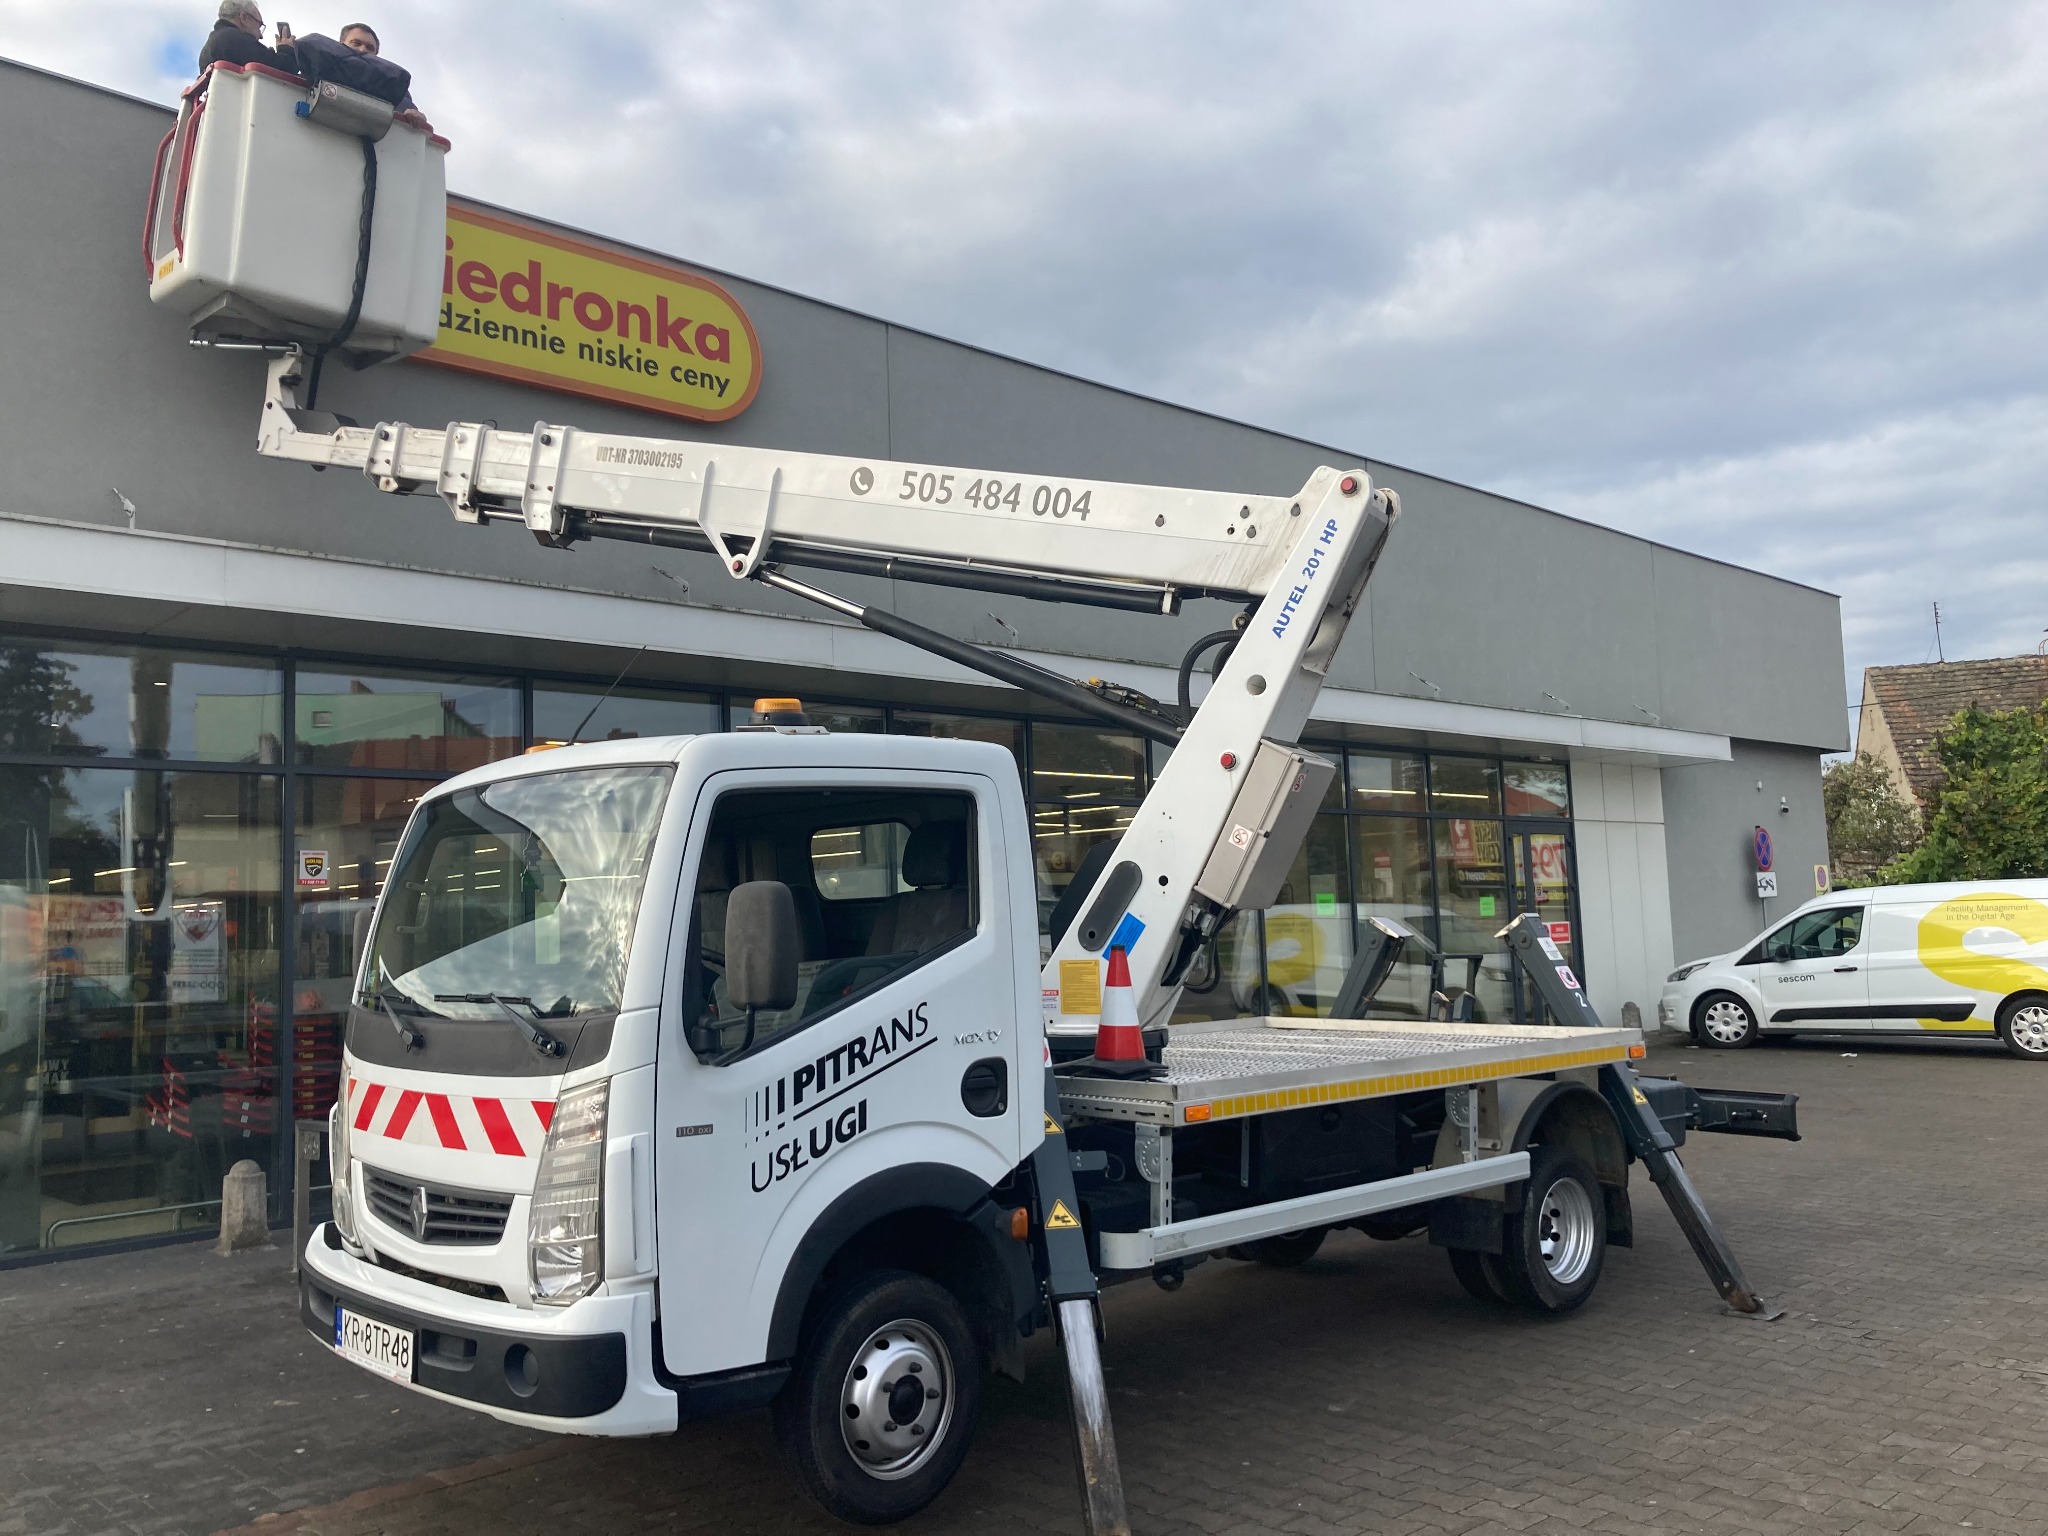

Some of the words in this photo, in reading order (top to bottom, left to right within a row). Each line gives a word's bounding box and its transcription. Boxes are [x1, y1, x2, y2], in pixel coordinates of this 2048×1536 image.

[443, 235, 731, 365] iedronka
[438, 301, 566, 355] dziennie
[578, 337, 659, 377] niskie
[670, 365, 731, 398] ceny
[898, 470, 955, 505] 505
[964, 478, 1022, 513] 484
[1032, 485, 1092, 521] 004
[1272, 584, 1308, 639] AUTEL
[1301, 547, 1326, 580] 201
[1319, 518, 1338, 545] HP
[1946, 905, 1974, 913] Facility
[1976, 904, 2029, 912] Management
[1946, 913, 1954, 921] in
[1971, 912, 1997, 921] Digital
[1999, 912, 2015, 921] Age
[1777, 974, 1816, 984] sescom
[793, 1001, 929, 1107] PITRANS
[751, 1098, 868, 1193] USŁUGI
